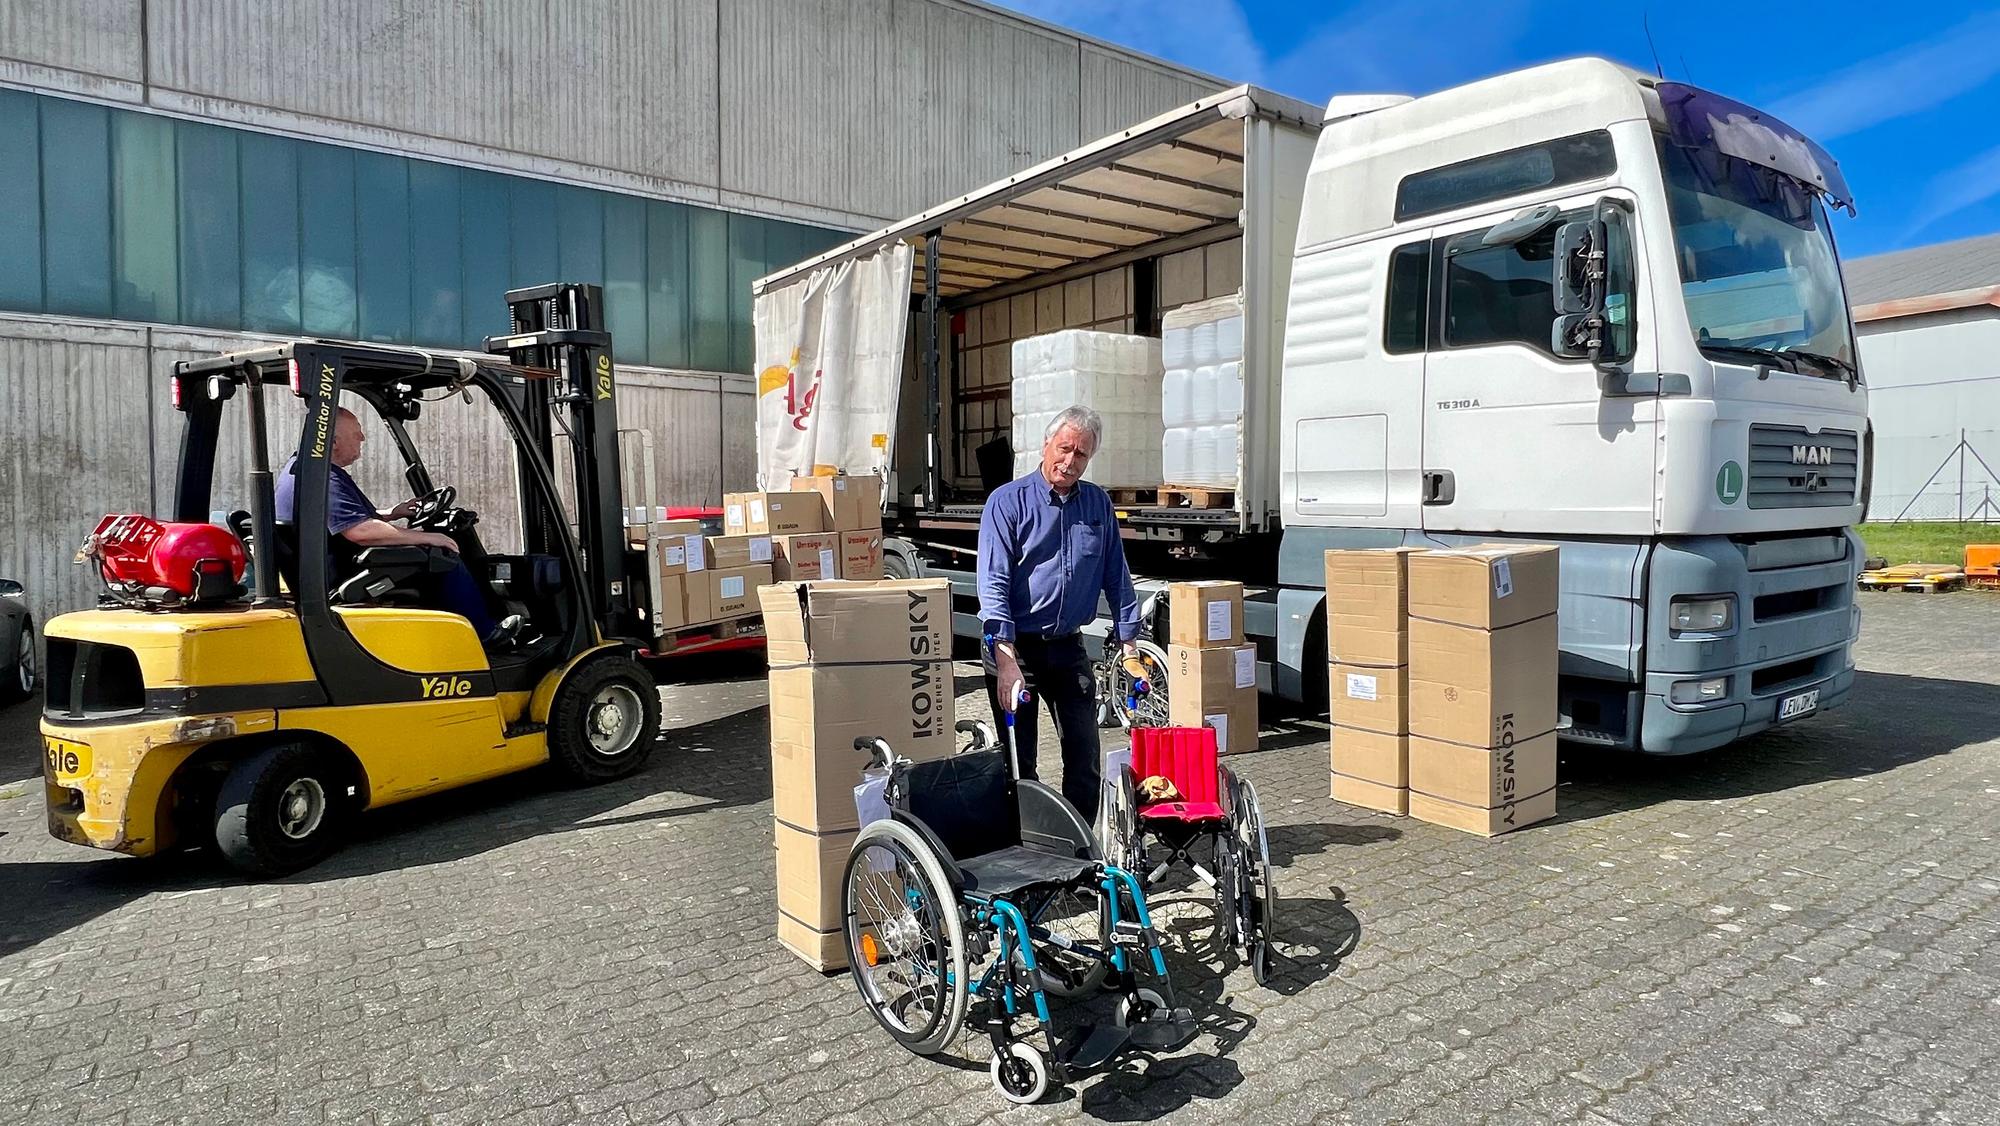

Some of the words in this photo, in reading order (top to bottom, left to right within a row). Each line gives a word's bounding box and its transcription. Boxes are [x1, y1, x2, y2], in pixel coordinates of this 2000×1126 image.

[319, 363, 336, 400] 30VX
[596, 355, 611, 400] Yale
[1451, 400, 1471, 409] 310
[1472, 399, 1480, 407] A
[311, 401, 330, 458] Veracitor
[1792, 445, 1832, 465] MAN
[1723, 467, 1736, 498] L
[908, 590, 932, 738] KOWSKY
[420, 675, 472, 698] Yale
[1502, 713, 1515, 825] KOWSKY
